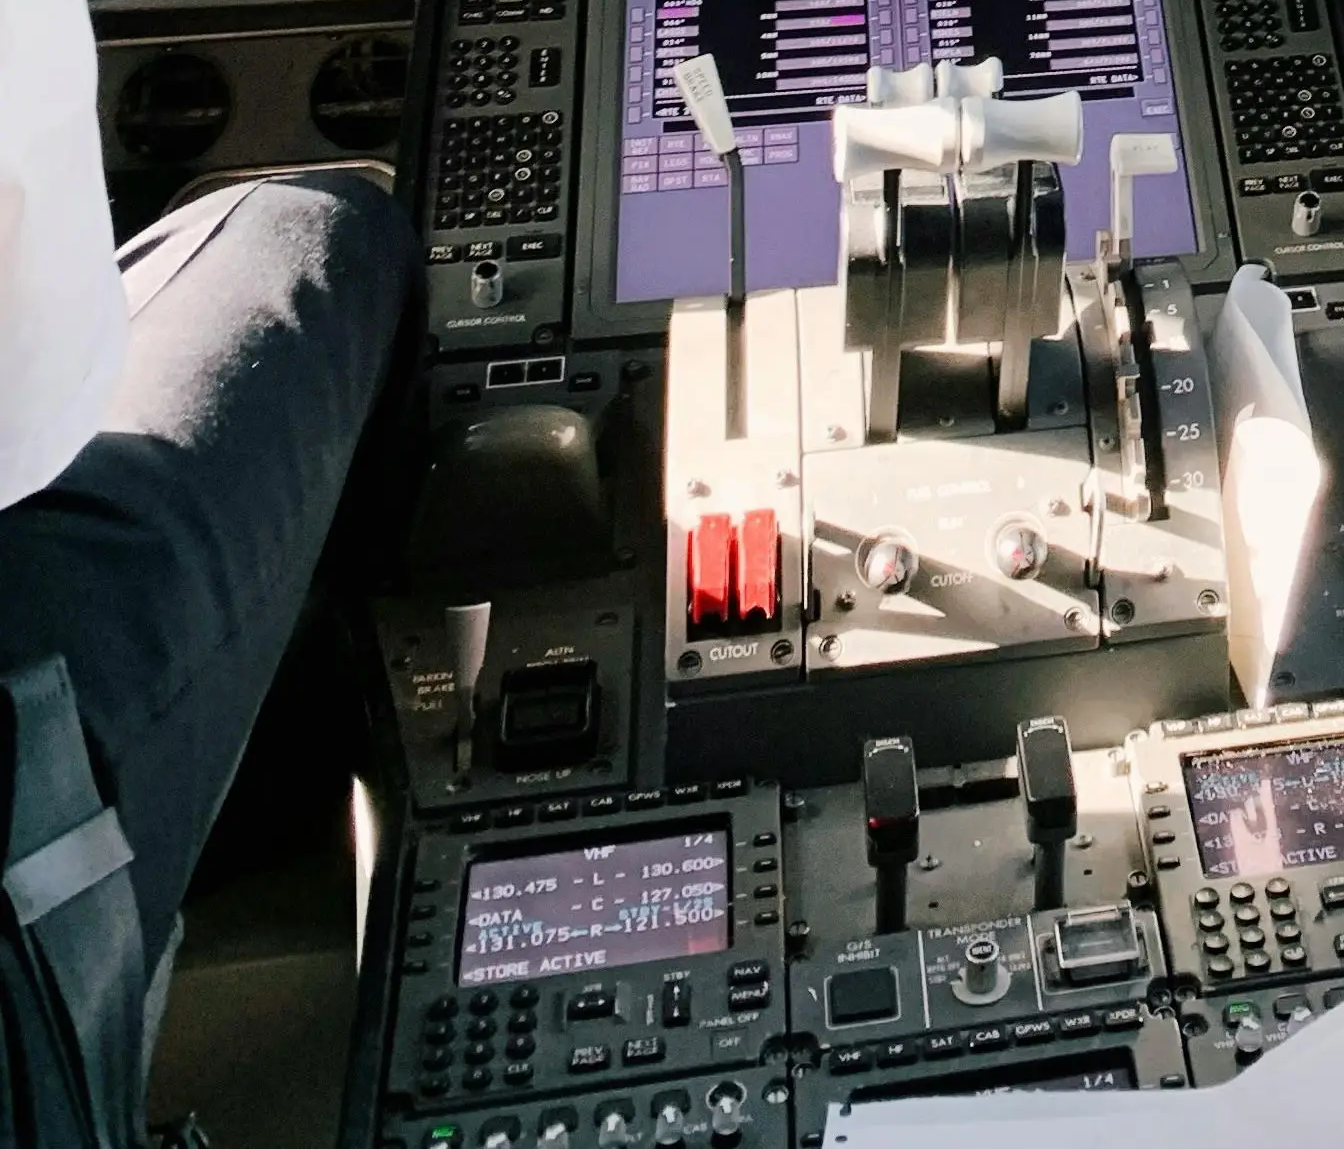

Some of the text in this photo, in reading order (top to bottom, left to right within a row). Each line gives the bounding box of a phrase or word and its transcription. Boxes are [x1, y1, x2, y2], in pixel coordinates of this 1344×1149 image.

[1324, 175, 1343, 183] EXEC
[471, 242, 493, 250] NEXT
[522, 241, 544, 251] EXEC
[1307, 242, 1344, 251] CONTROL
[1168, 304, 1177, 315] 5
[1173, 378, 1194, 394] 20
[1178, 423, 1200, 441] 25
[1183, 471, 1204, 489] 30
[709, 643, 759, 661] CUTOUT
[591, 797, 612, 807] CAB
[628, 791, 661, 802] GPWS
[549, 801, 569, 812] SAT
[1314, 822, 1326, 835] R
[685, 834, 713, 847] 1/4
[584, 845, 617, 861] VHF
[1282, 847, 1337, 865] ACTIVE
[480, 857, 713, 901] 130.475 L 130.600
[592, 882, 713, 911] C 127.050
[478, 909, 523, 927] DATA
[480, 908, 714, 955] 131.075 R 121.500
[927, 917, 1022, 940] TRANSPONDER
[956, 931, 996, 943] MODE
[847, 939, 872, 951] G/S
[474, 951, 606, 982] STORE ACTIVE
[734, 965, 763, 977] NAV
[663, 970, 690, 981] STBY
[731, 989, 766, 1001] MENU
[1064, 1014, 1091, 1027] WXR
[1015, 1020, 1050, 1035] GPWS
[931, 1036, 954, 1048] SAT
[975, 1029, 1000, 1042] CAB
[839, 1051, 861, 1063] VHF
[1084, 1073, 1114, 1088] 1/4
